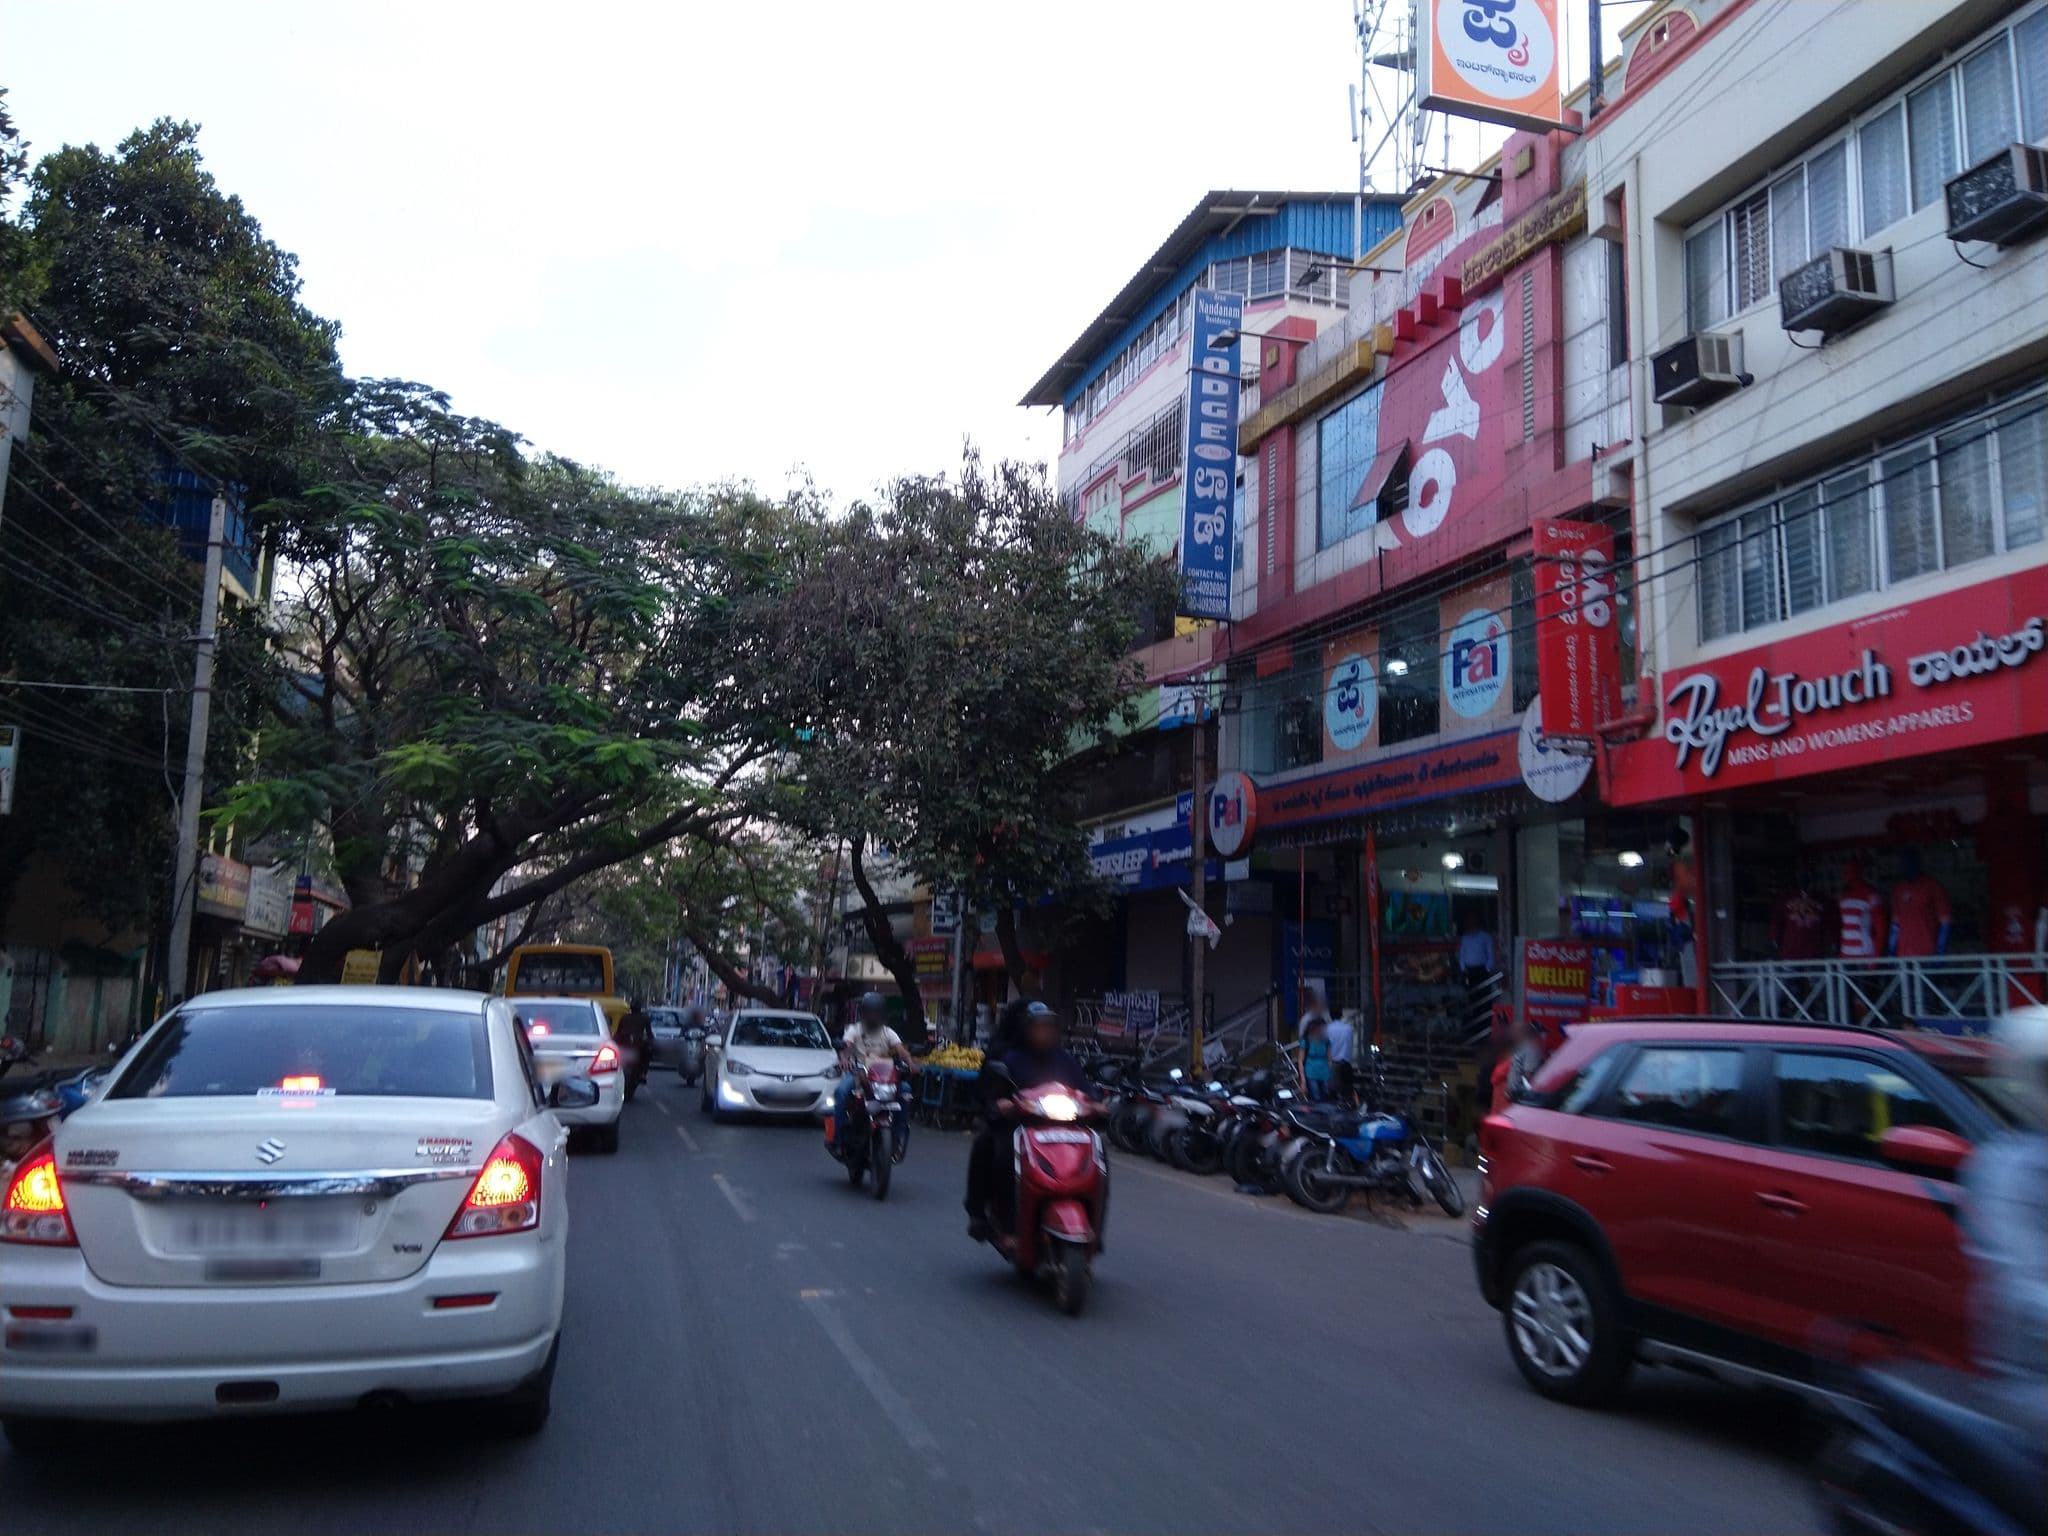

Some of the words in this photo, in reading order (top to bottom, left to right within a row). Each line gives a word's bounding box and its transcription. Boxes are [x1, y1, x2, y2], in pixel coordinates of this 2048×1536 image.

[1198, 299, 1240, 319] Nandanam
[1200, 334, 1231, 441] LODGE
[1187, 567, 1213, 579] CONTACT
[1452, 622, 1499, 689] Pai
[1452, 681, 1500, 701] INTERNATIONAL
[1665, 667, 1793, 777] Royal
[1727, 741, 1770, 767] MENS
[1771, 734, 1805, 760] AND
[1808, 717, 1886, 751] WOMENS
[1886, 701, 1975, 737] APPARELS
[1213, 787, 1242, 829] Pai
